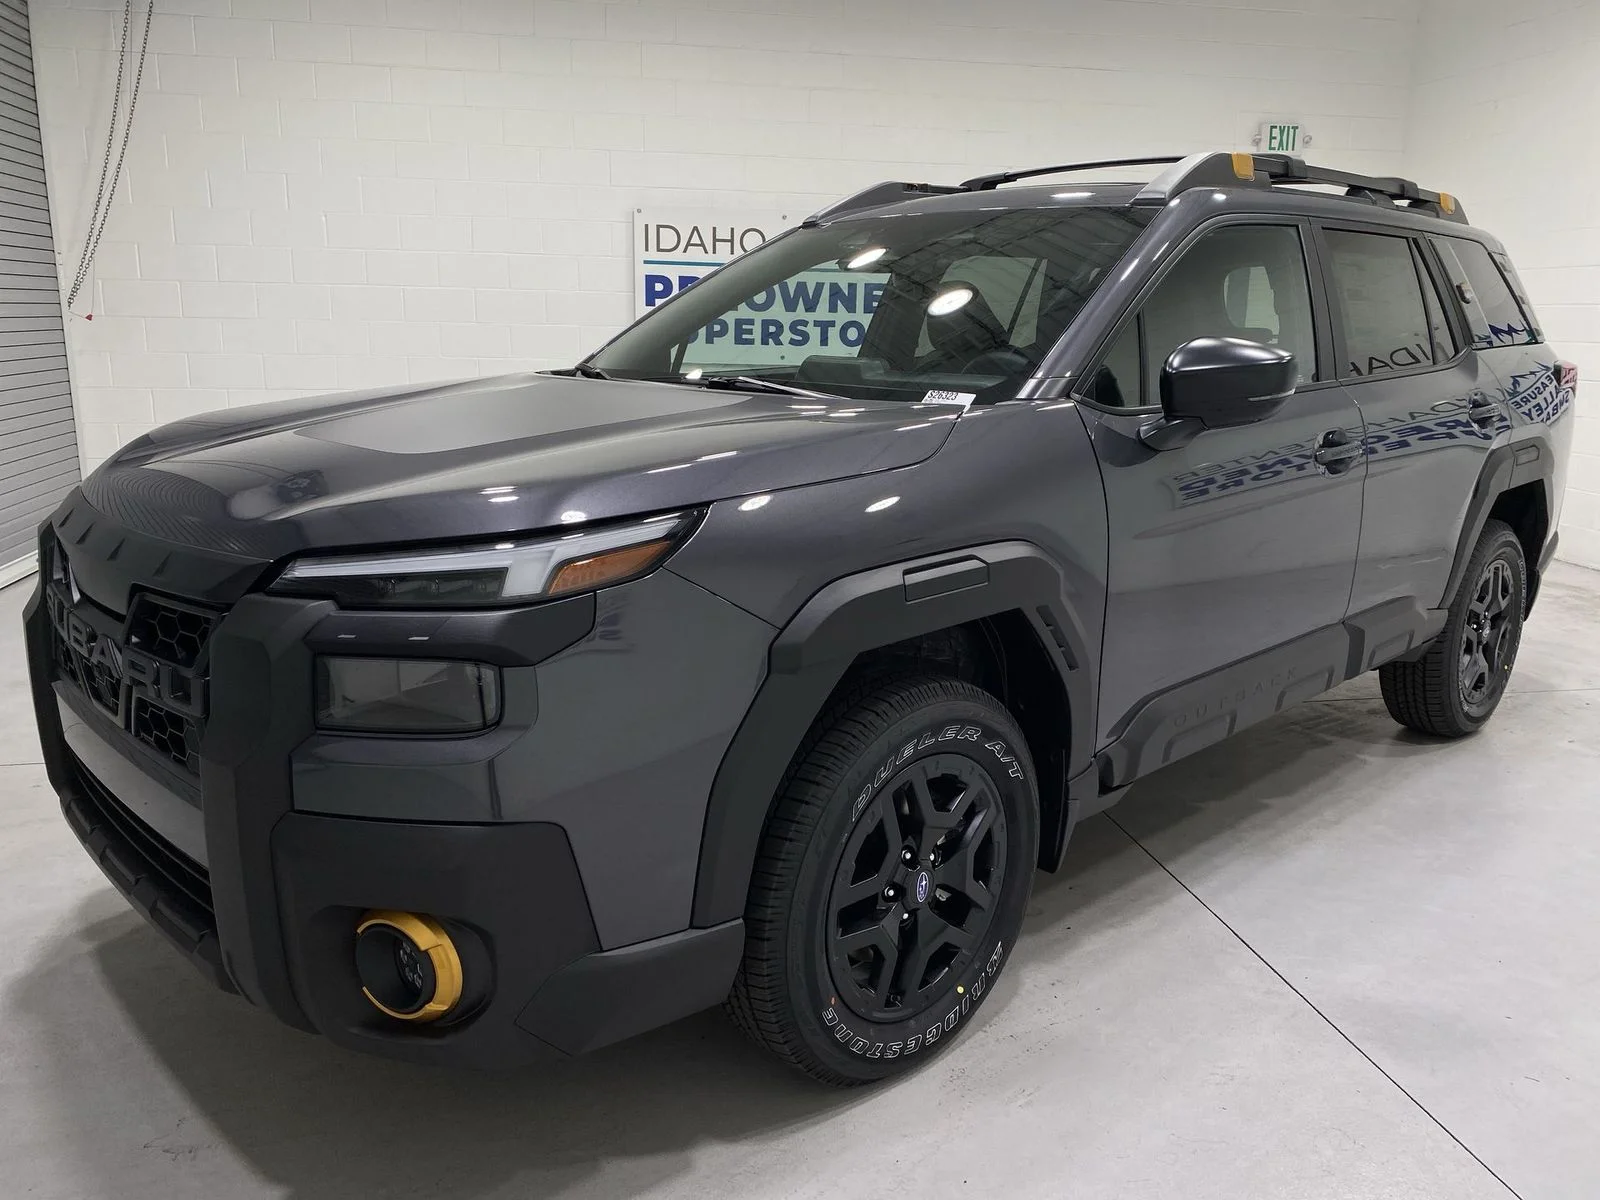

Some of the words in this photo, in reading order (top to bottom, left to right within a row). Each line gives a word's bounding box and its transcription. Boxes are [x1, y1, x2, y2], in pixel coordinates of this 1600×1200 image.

[1268, 125, 1299, 151] EXIT
[644, 223, 767, 255] IDAHO
[686, 318, 866, 348] PERSTO
[852, 725, 982, 821] DUELER
[984, 740, 1025, 780] A/T
[822, 940, 1003, 1059] BRIDGESTONE
